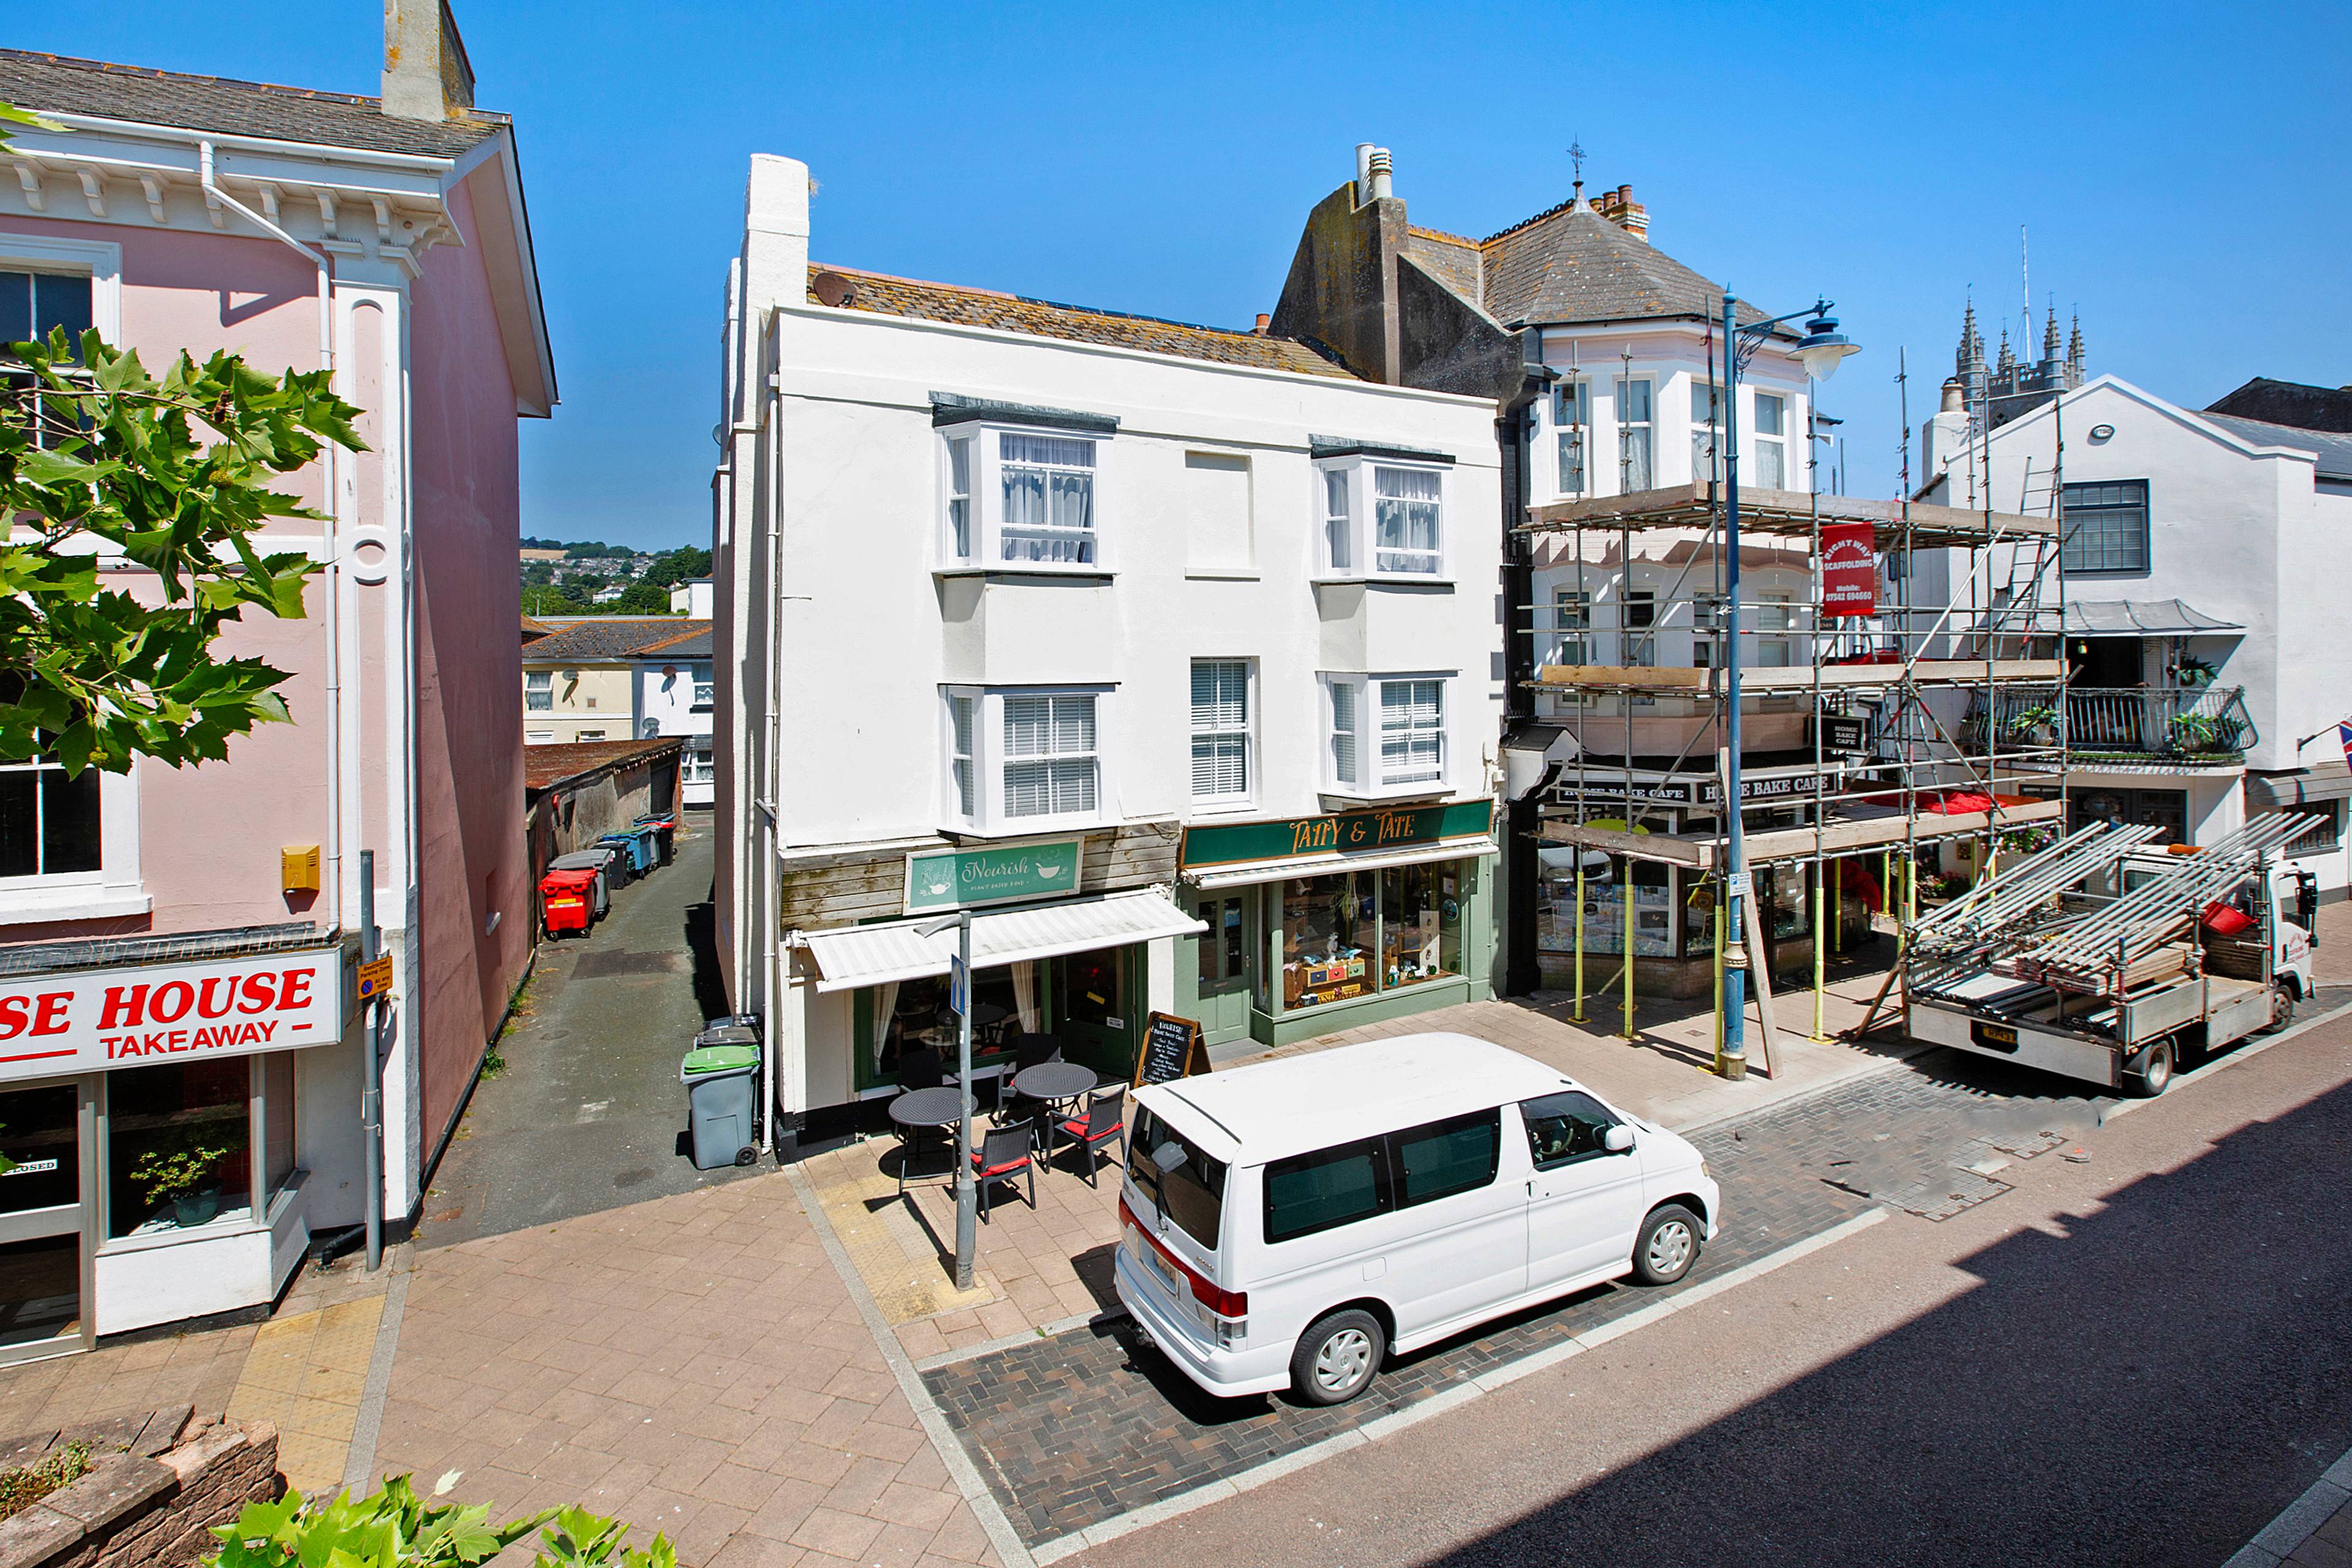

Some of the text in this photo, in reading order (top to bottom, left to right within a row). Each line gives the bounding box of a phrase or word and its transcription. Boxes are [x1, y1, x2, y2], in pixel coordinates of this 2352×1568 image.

[1824, 559, 1873, 571] SCAFFOLDING
[1648, 789, 1684, 799] CAFE
[1705, 775, 1828, 800] HE BAKE CAFE
[1289, 812, 1415, 854] TATTY & TATE
[961, 858, 1030, 883] Nourish
[360, 970, 377, 978] Parking
[96, 967, 316, 1030] HOUSE
[100, 1020, 279, 1060] TAKEAWAY
[6, 1162, 55, 1174] LOSED
